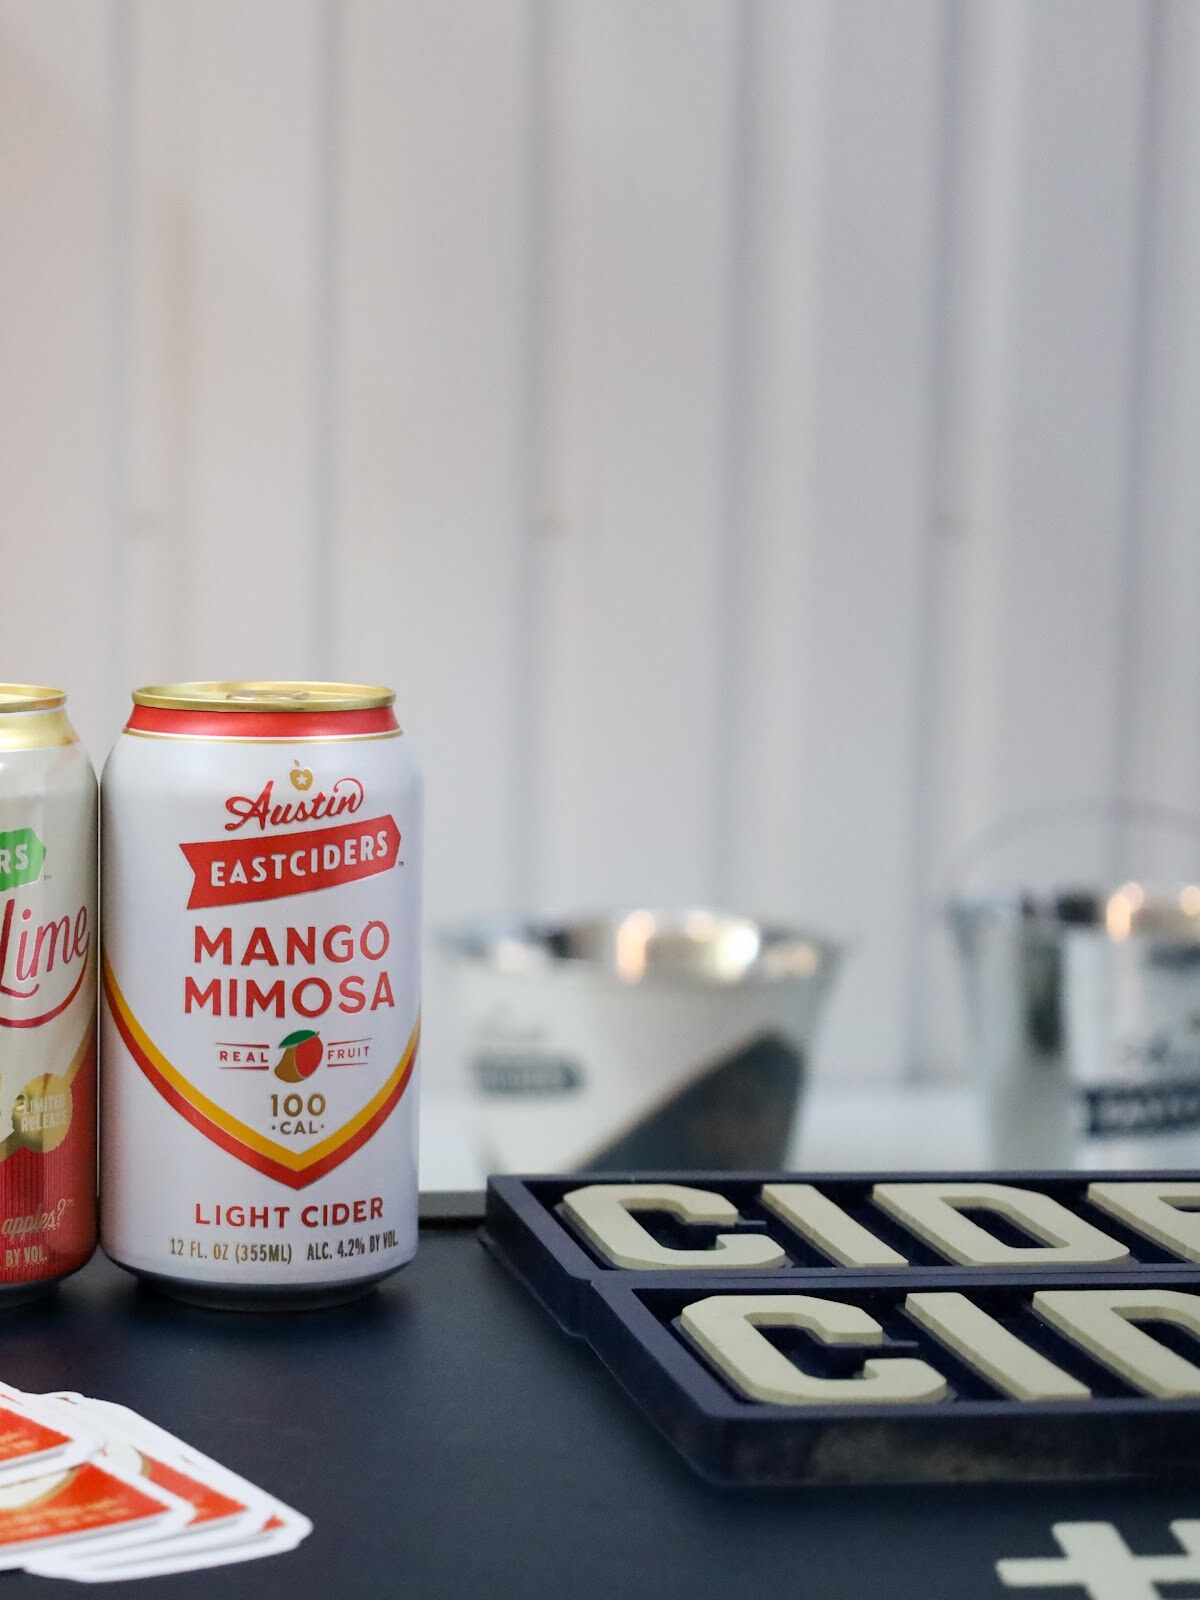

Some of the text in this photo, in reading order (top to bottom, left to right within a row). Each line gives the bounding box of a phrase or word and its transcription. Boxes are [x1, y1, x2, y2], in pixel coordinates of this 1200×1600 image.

[224, 777, 364, 831] Austin
[210, 830, 389, 888] EASTCIDERS
[193, 919, 391, 967] MANGO
[184, 971, 396, 1019] MIMOSA
[219, 1045, 370, 1063] REAL FRUIT
[270, 1093, 327, 1118] 100
[195, 1197, 384, 1229] LIGHT CIDER
[5, 1248, 21, 1268] BY
[23, 1244, 48, 1265] VOL.
[170, 1230, 399, 1265] 12 FL. OZ (355ML) ALC. 4.2% BY VOL.
